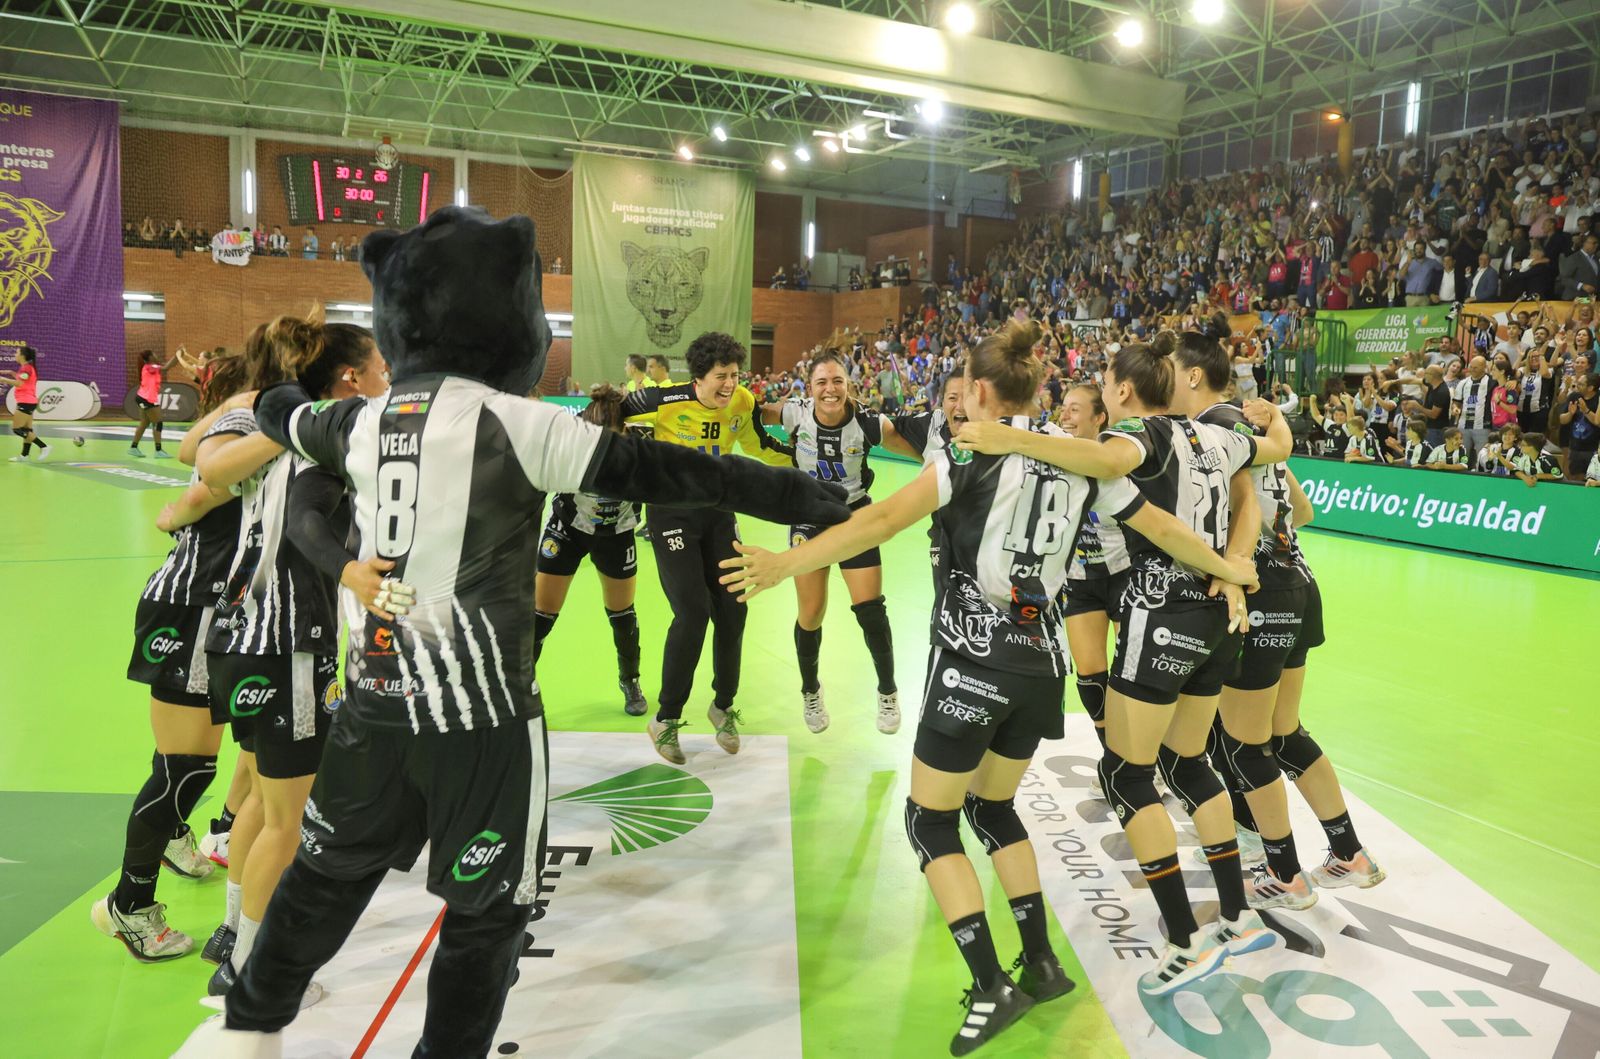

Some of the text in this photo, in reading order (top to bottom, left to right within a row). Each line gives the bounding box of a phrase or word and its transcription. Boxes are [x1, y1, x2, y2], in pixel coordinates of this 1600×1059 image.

[3, 157, 48, 169] presa
[336, 167, 350, 179] 30
[345, 187, 374, 201] 30:00
[647, 207, 690, 217] cazamos
[644, 225, 692, 237] CBFMCS
[1385, 315, 1407, 327] LIGA
[1355, 328, 1409, 340] GUERRERAS
[1355, 341, 1407, 353] IBERDROLA
[701, 421, 720, 439] 38
[381, 433, 419, 456] VEGA
[824, 443, 836, 457] 6
[376, 461, 418, 558] 8
[1003, 472, 1070, 556] 18
[1300, 479, 1546, 536] Objetivo: Igualdad
[667, 536, 685, 551] 38
[151, 636, 184, 654] CSIF
[1172, 632, 1206, 647] SERVICIOS
[960, 674, 999, 693] SERVICIOS
[236, 688, 277, 705] CSIF
[959, 681, 1010, 705] INMOBILIARIOS
[937, 699, 993, 726] TORRES
[461, 842, 507, 866] CSIF
[1022, 792, 1068, 823] FOR
[1045, 828, 1104, 880] YOUR
[1079, 888, 1159, 960] HOME
